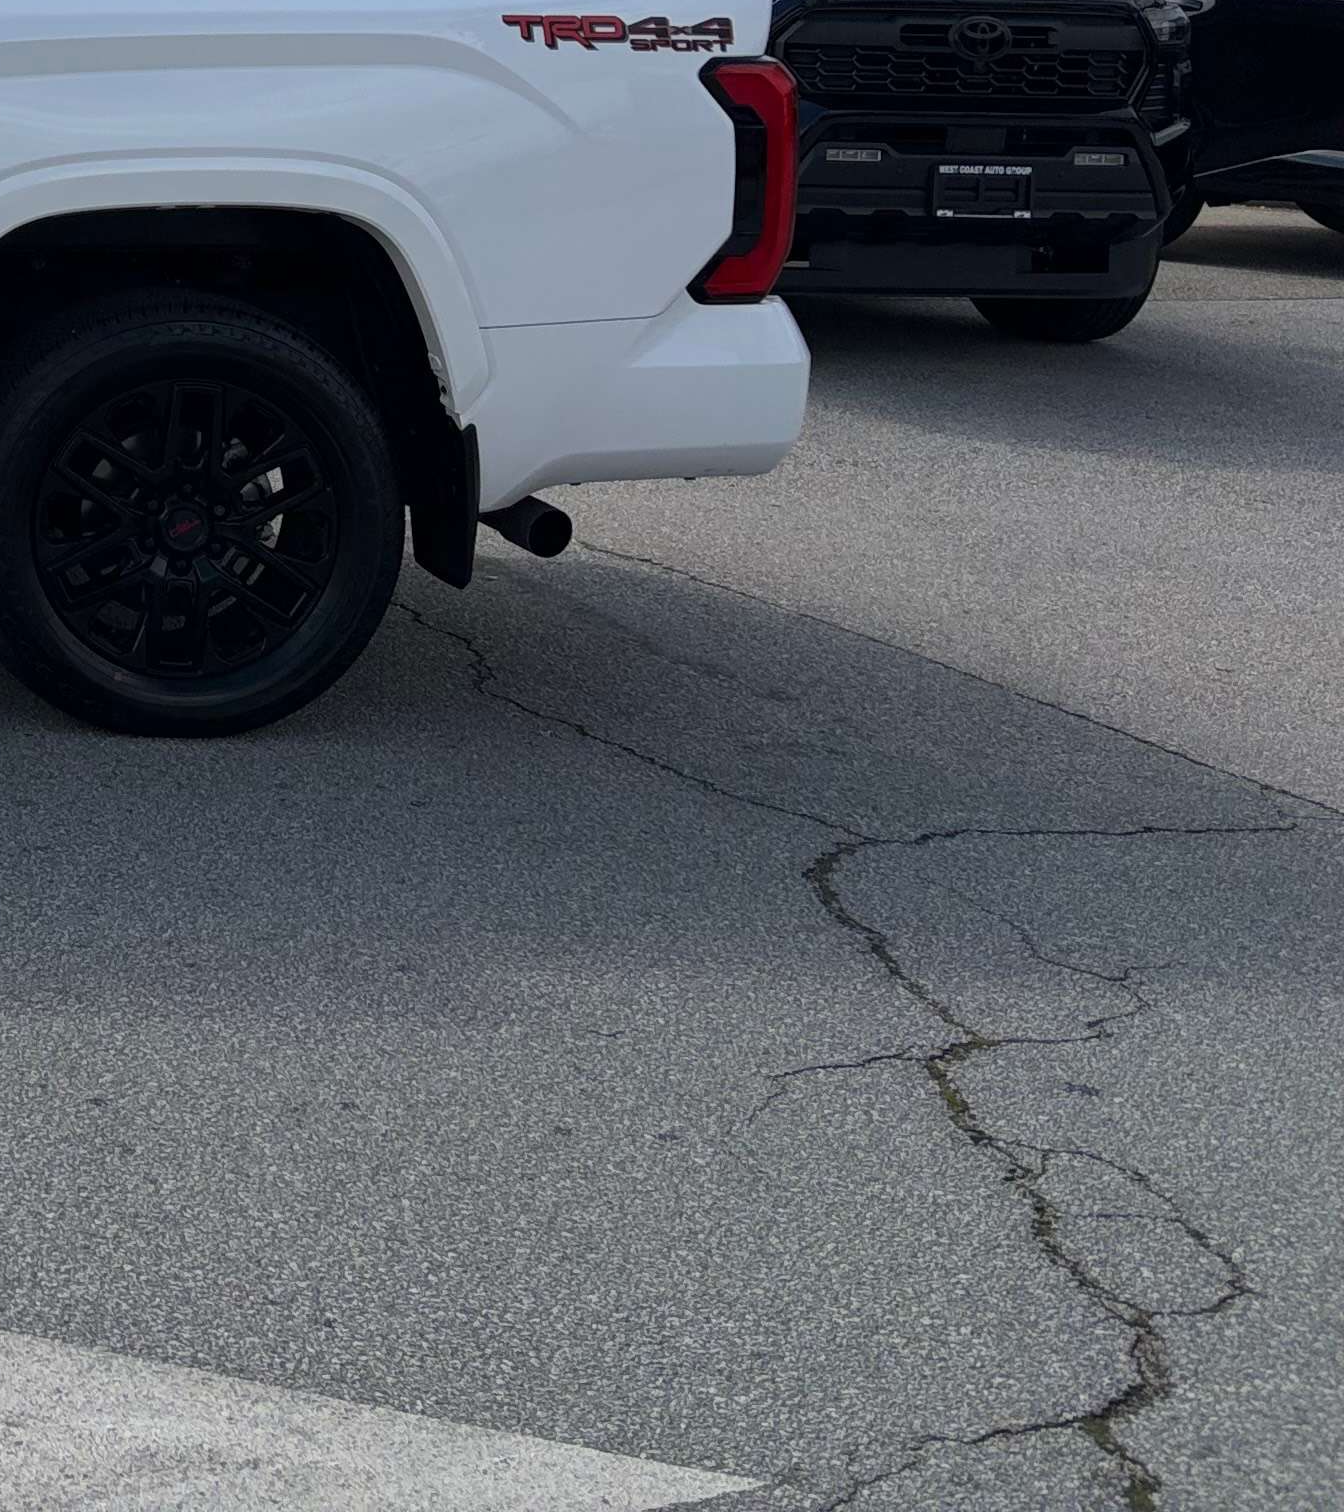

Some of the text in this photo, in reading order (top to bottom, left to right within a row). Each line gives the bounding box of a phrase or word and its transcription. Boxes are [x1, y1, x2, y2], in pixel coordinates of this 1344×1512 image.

[502, 15, 629, 51] TRD
[629, 39, 734, 53] SPORT
[959, 165, 984, 175] COAST
[984, 166, 1005, 175] AUTO
